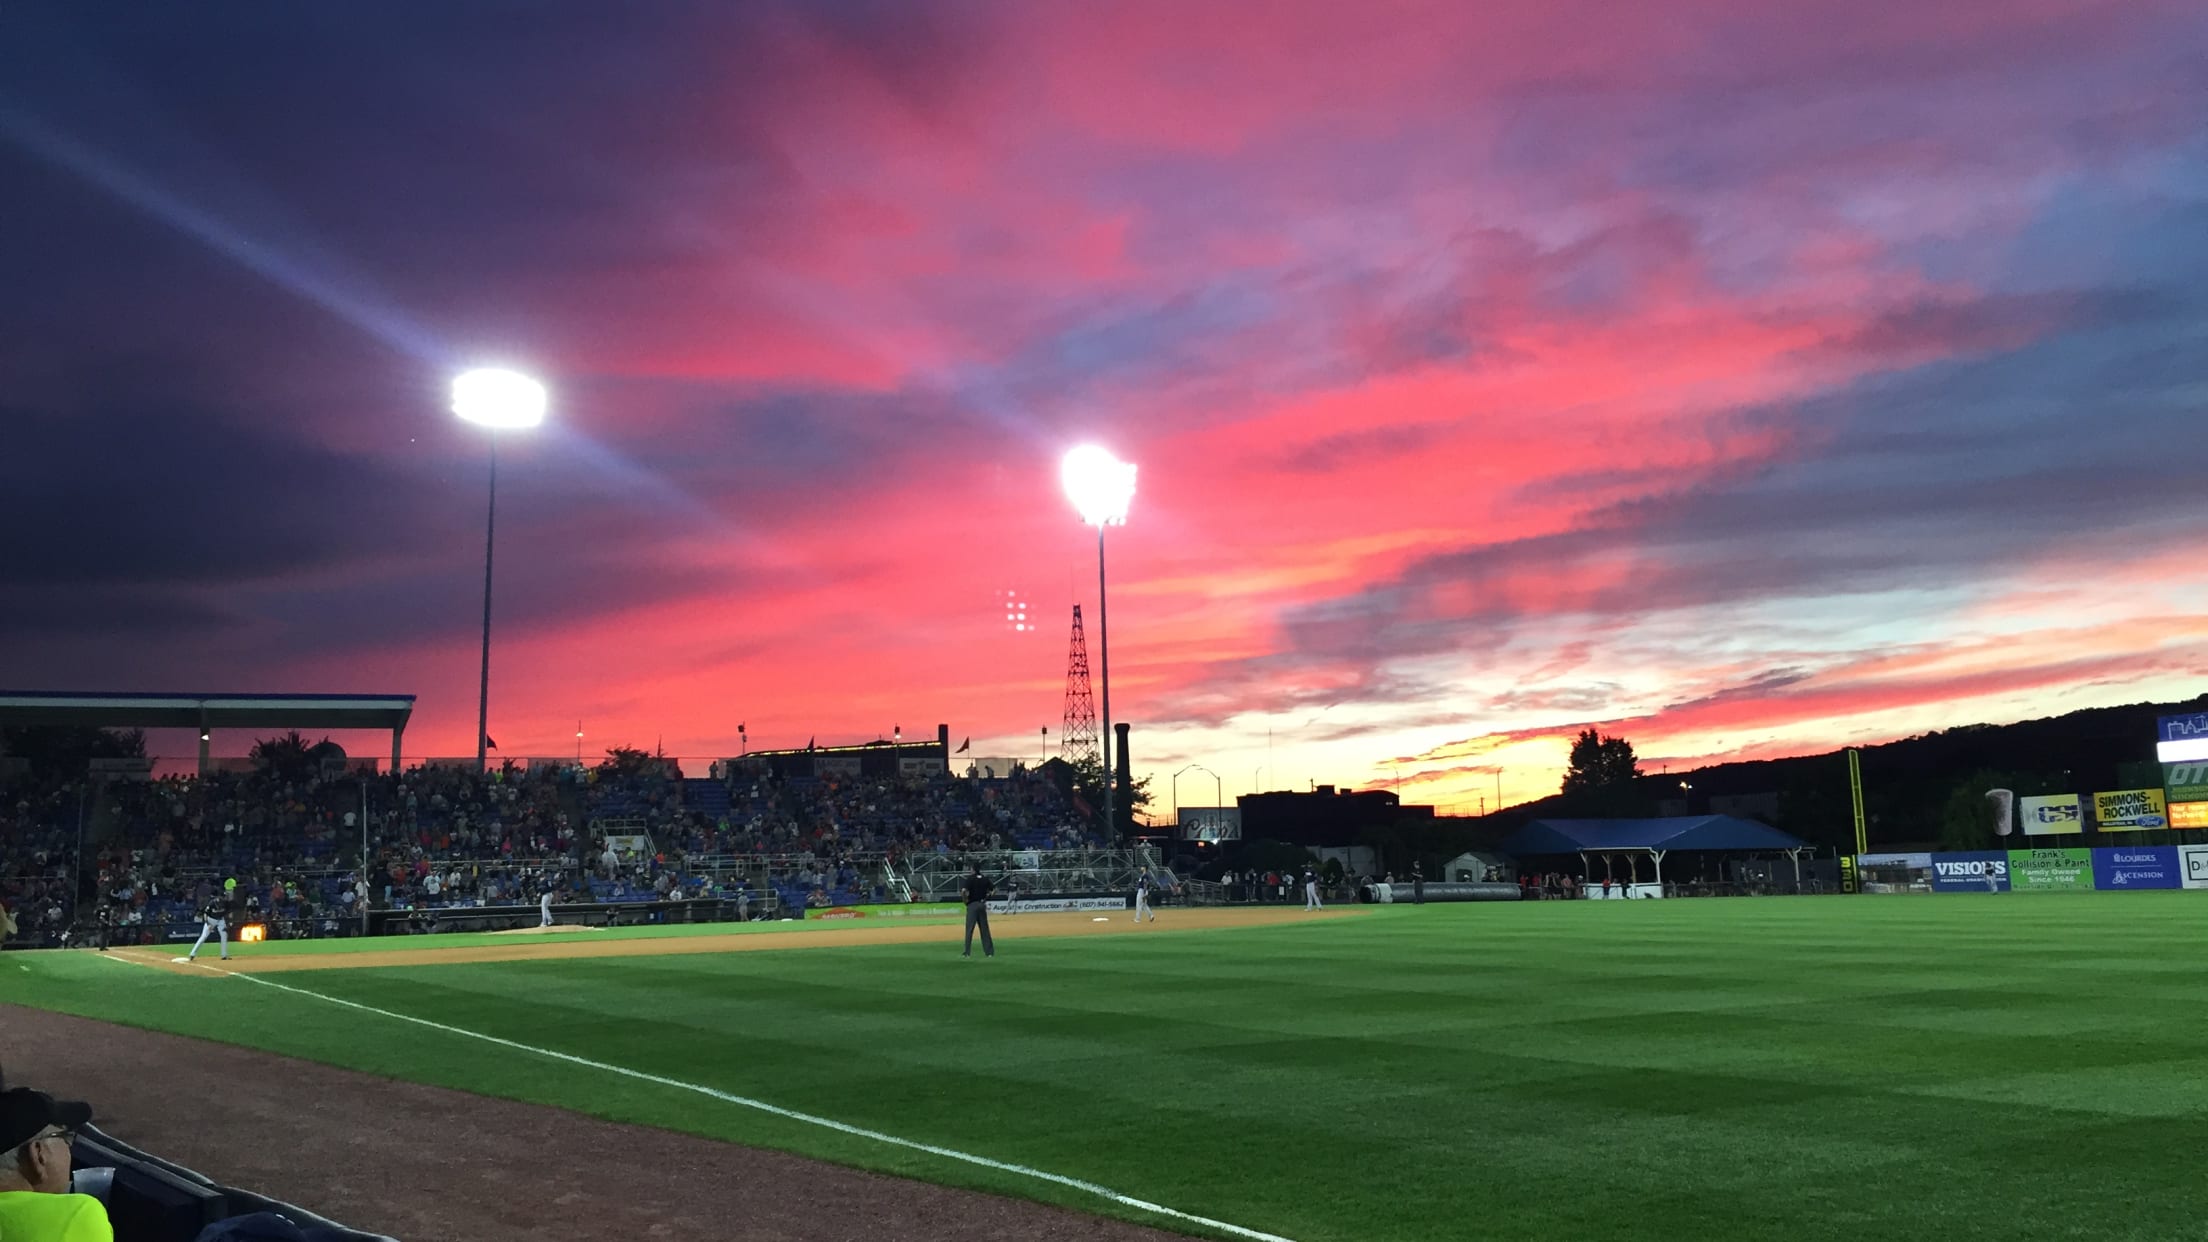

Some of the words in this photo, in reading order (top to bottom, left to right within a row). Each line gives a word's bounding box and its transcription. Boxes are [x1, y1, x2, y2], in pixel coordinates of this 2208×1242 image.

[2168, 763, 2208, 785] OT
[2098, 792, 2151, 808] SIMMONS-
[2104, 803, 2161, 819] ROCKWELL
[2032, 850, 2066, 859] Frank's
[2120, 854, 2156, 862] LOURDES
[2011, 859, 2051, 868] Collision
[2054, 859, 2061, 868] &
[2065, 858, 2090, 867] Paint
